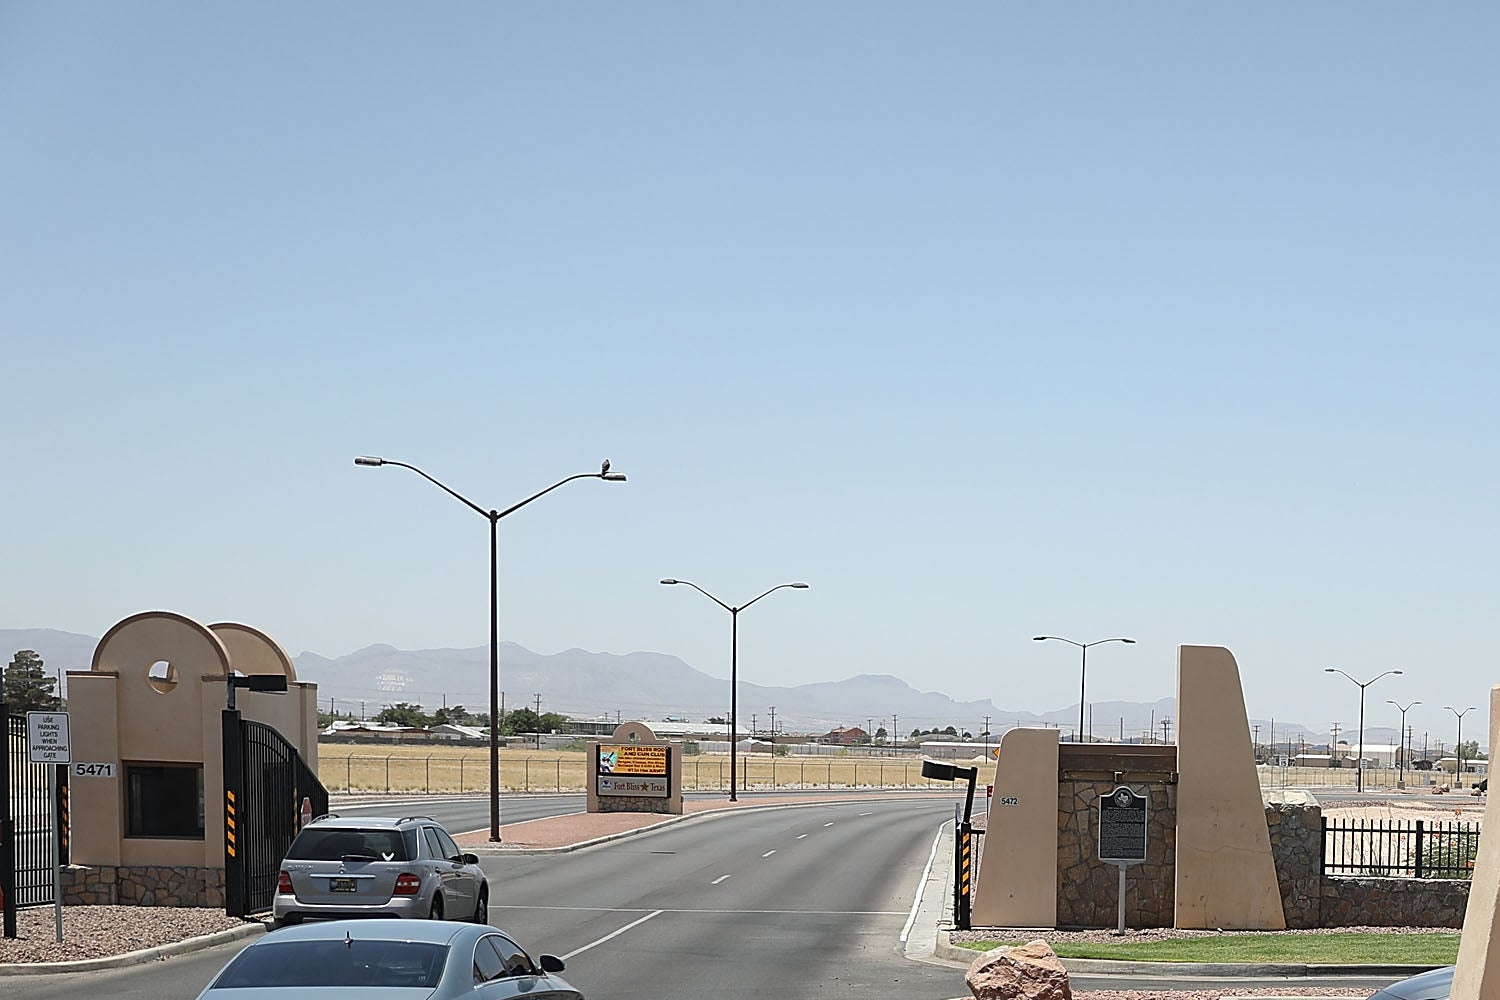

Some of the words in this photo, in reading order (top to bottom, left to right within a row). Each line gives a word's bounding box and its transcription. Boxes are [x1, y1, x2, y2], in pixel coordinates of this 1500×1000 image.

[76, 764, 111, 776] 5471
[614, 782, 625, 790] Fort
[627, 782, 640, 791] Bliss
[650, 783, 665, 791] Texas
